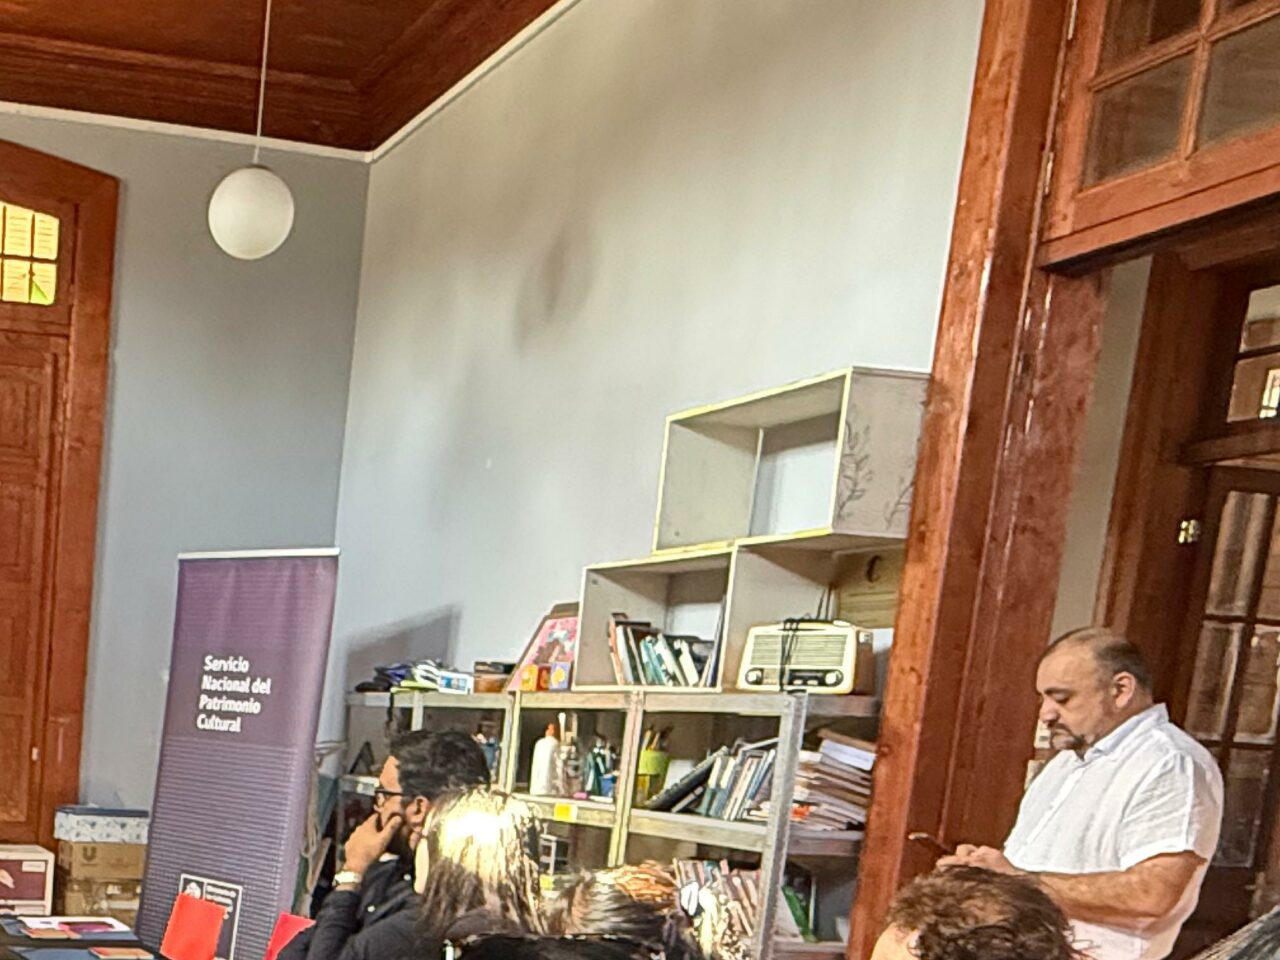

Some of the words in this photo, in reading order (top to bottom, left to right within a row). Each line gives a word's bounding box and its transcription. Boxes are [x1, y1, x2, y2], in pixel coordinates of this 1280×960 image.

[203, 655, 249, 673] Servicio
[201, 674, 250, 693] Nacional
[251, 677, 271, 695] del
[199, 694, 261, 714] Patrimonio
[196, 713, 241, 732] Cultural
